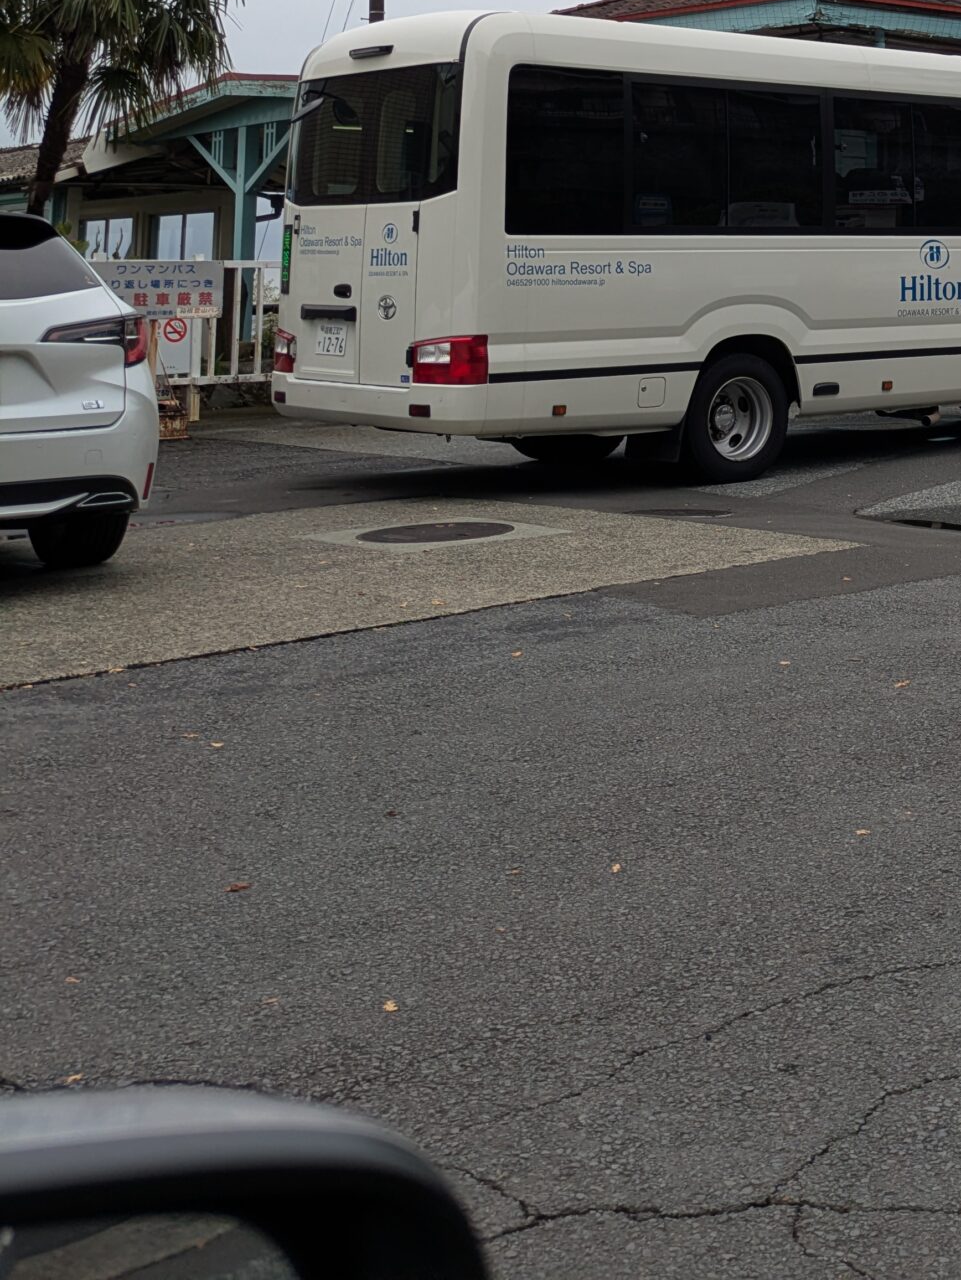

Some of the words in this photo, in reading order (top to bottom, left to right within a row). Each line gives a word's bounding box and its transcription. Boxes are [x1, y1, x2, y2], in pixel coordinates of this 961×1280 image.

[350, 236, 362, 247] Spa
[507, 245, 545, 258] Hilton
[370, 248, 408, 267] Hilton
[116, 264, 196, 275] ワンマンバス
[507, 261, 566, 276] Odawara
[570, 261, 612, 274] Resort
[615, 261, 624, 273] &
[628, 260, 652, 276] Spa
[104, 279, 213, 289] り返し場所につき
[507, 278, 550, 287] 0465291000
[551, 278, 605, 286] hiltonodawara.jp
[133, 292, 213, 307] 駐車厳禁
[897, 308, 930, 318] ODAWARA
[931, 307, 954, 317] RESORT
